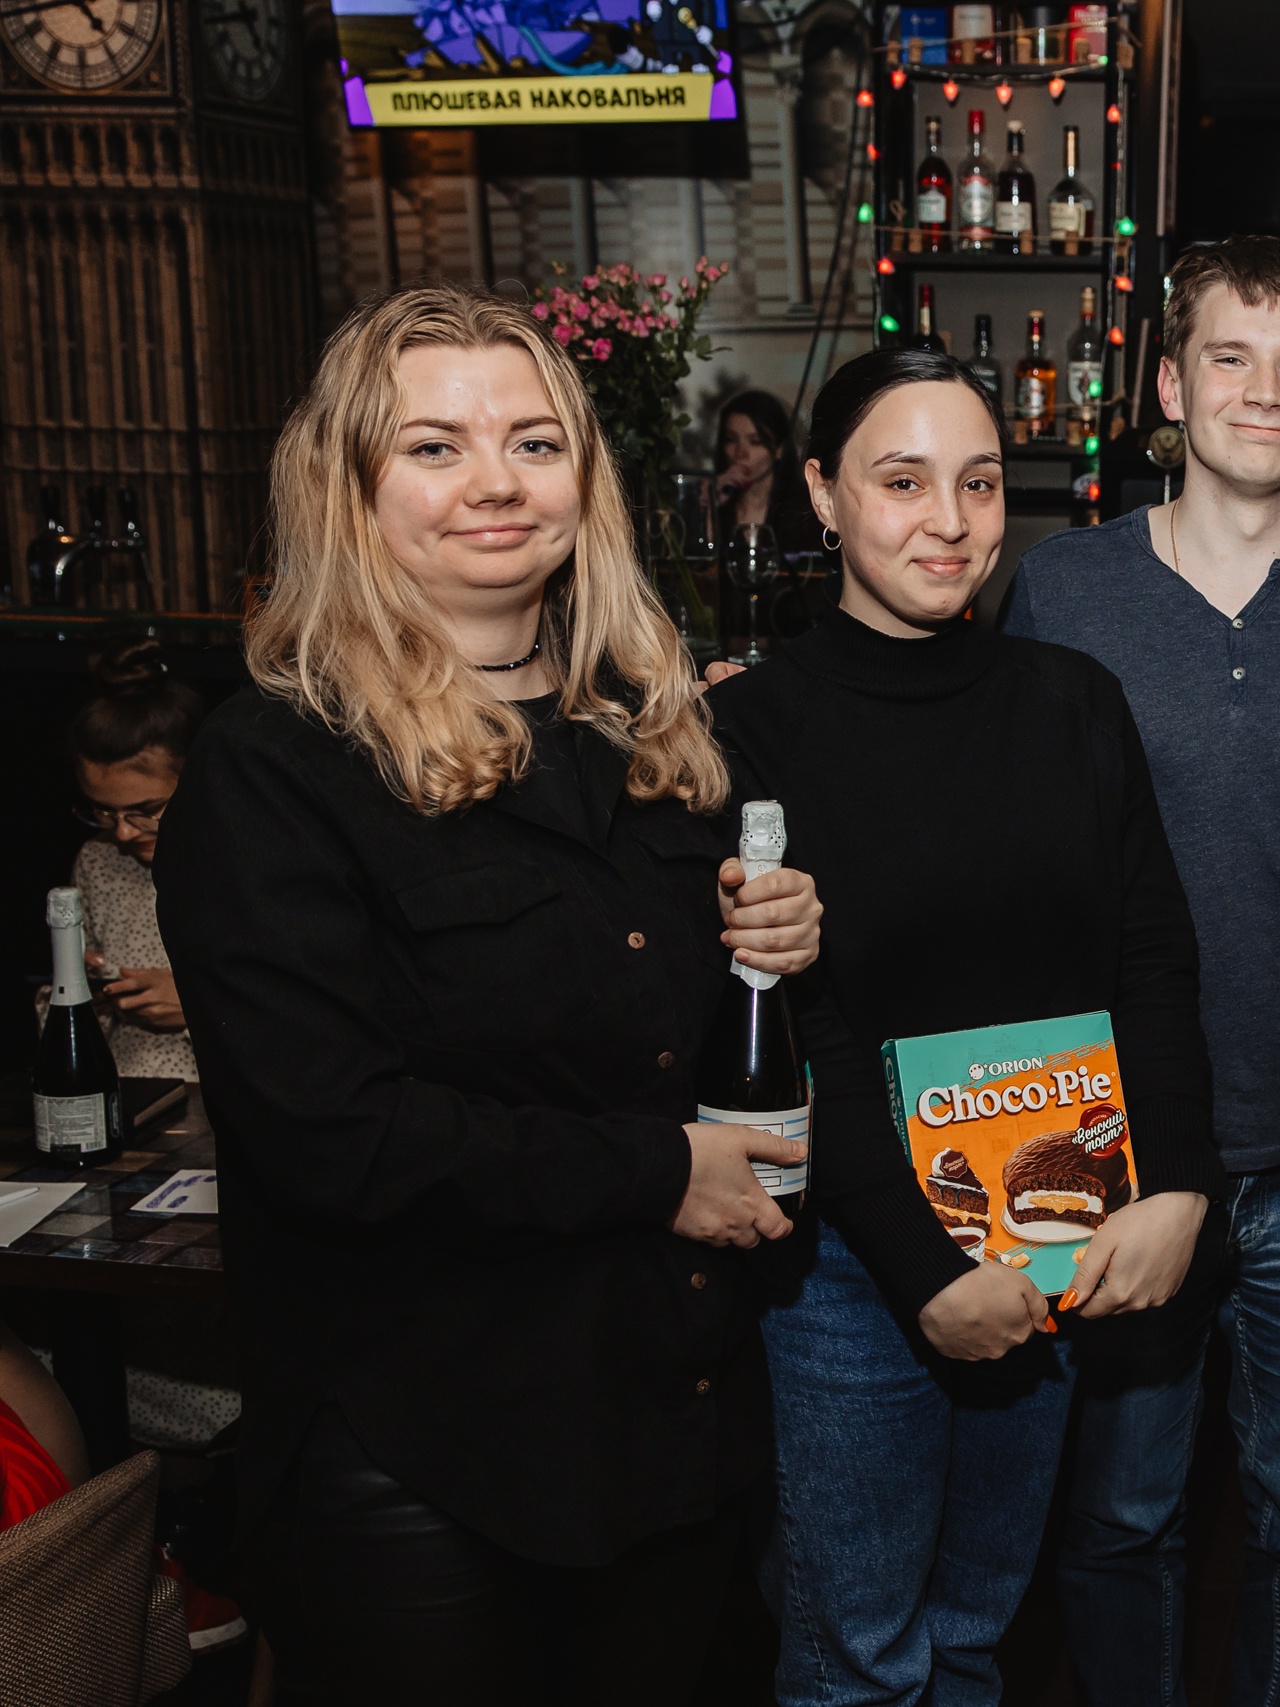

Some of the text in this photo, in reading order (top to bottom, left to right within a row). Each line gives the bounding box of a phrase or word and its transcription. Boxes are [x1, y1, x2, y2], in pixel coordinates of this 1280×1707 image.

[391, 87, 686, 111] ПЛЮШЕВАЯ НАКОВАЛЬНЯ
[988, 1056, 1044, 1076] ORION
